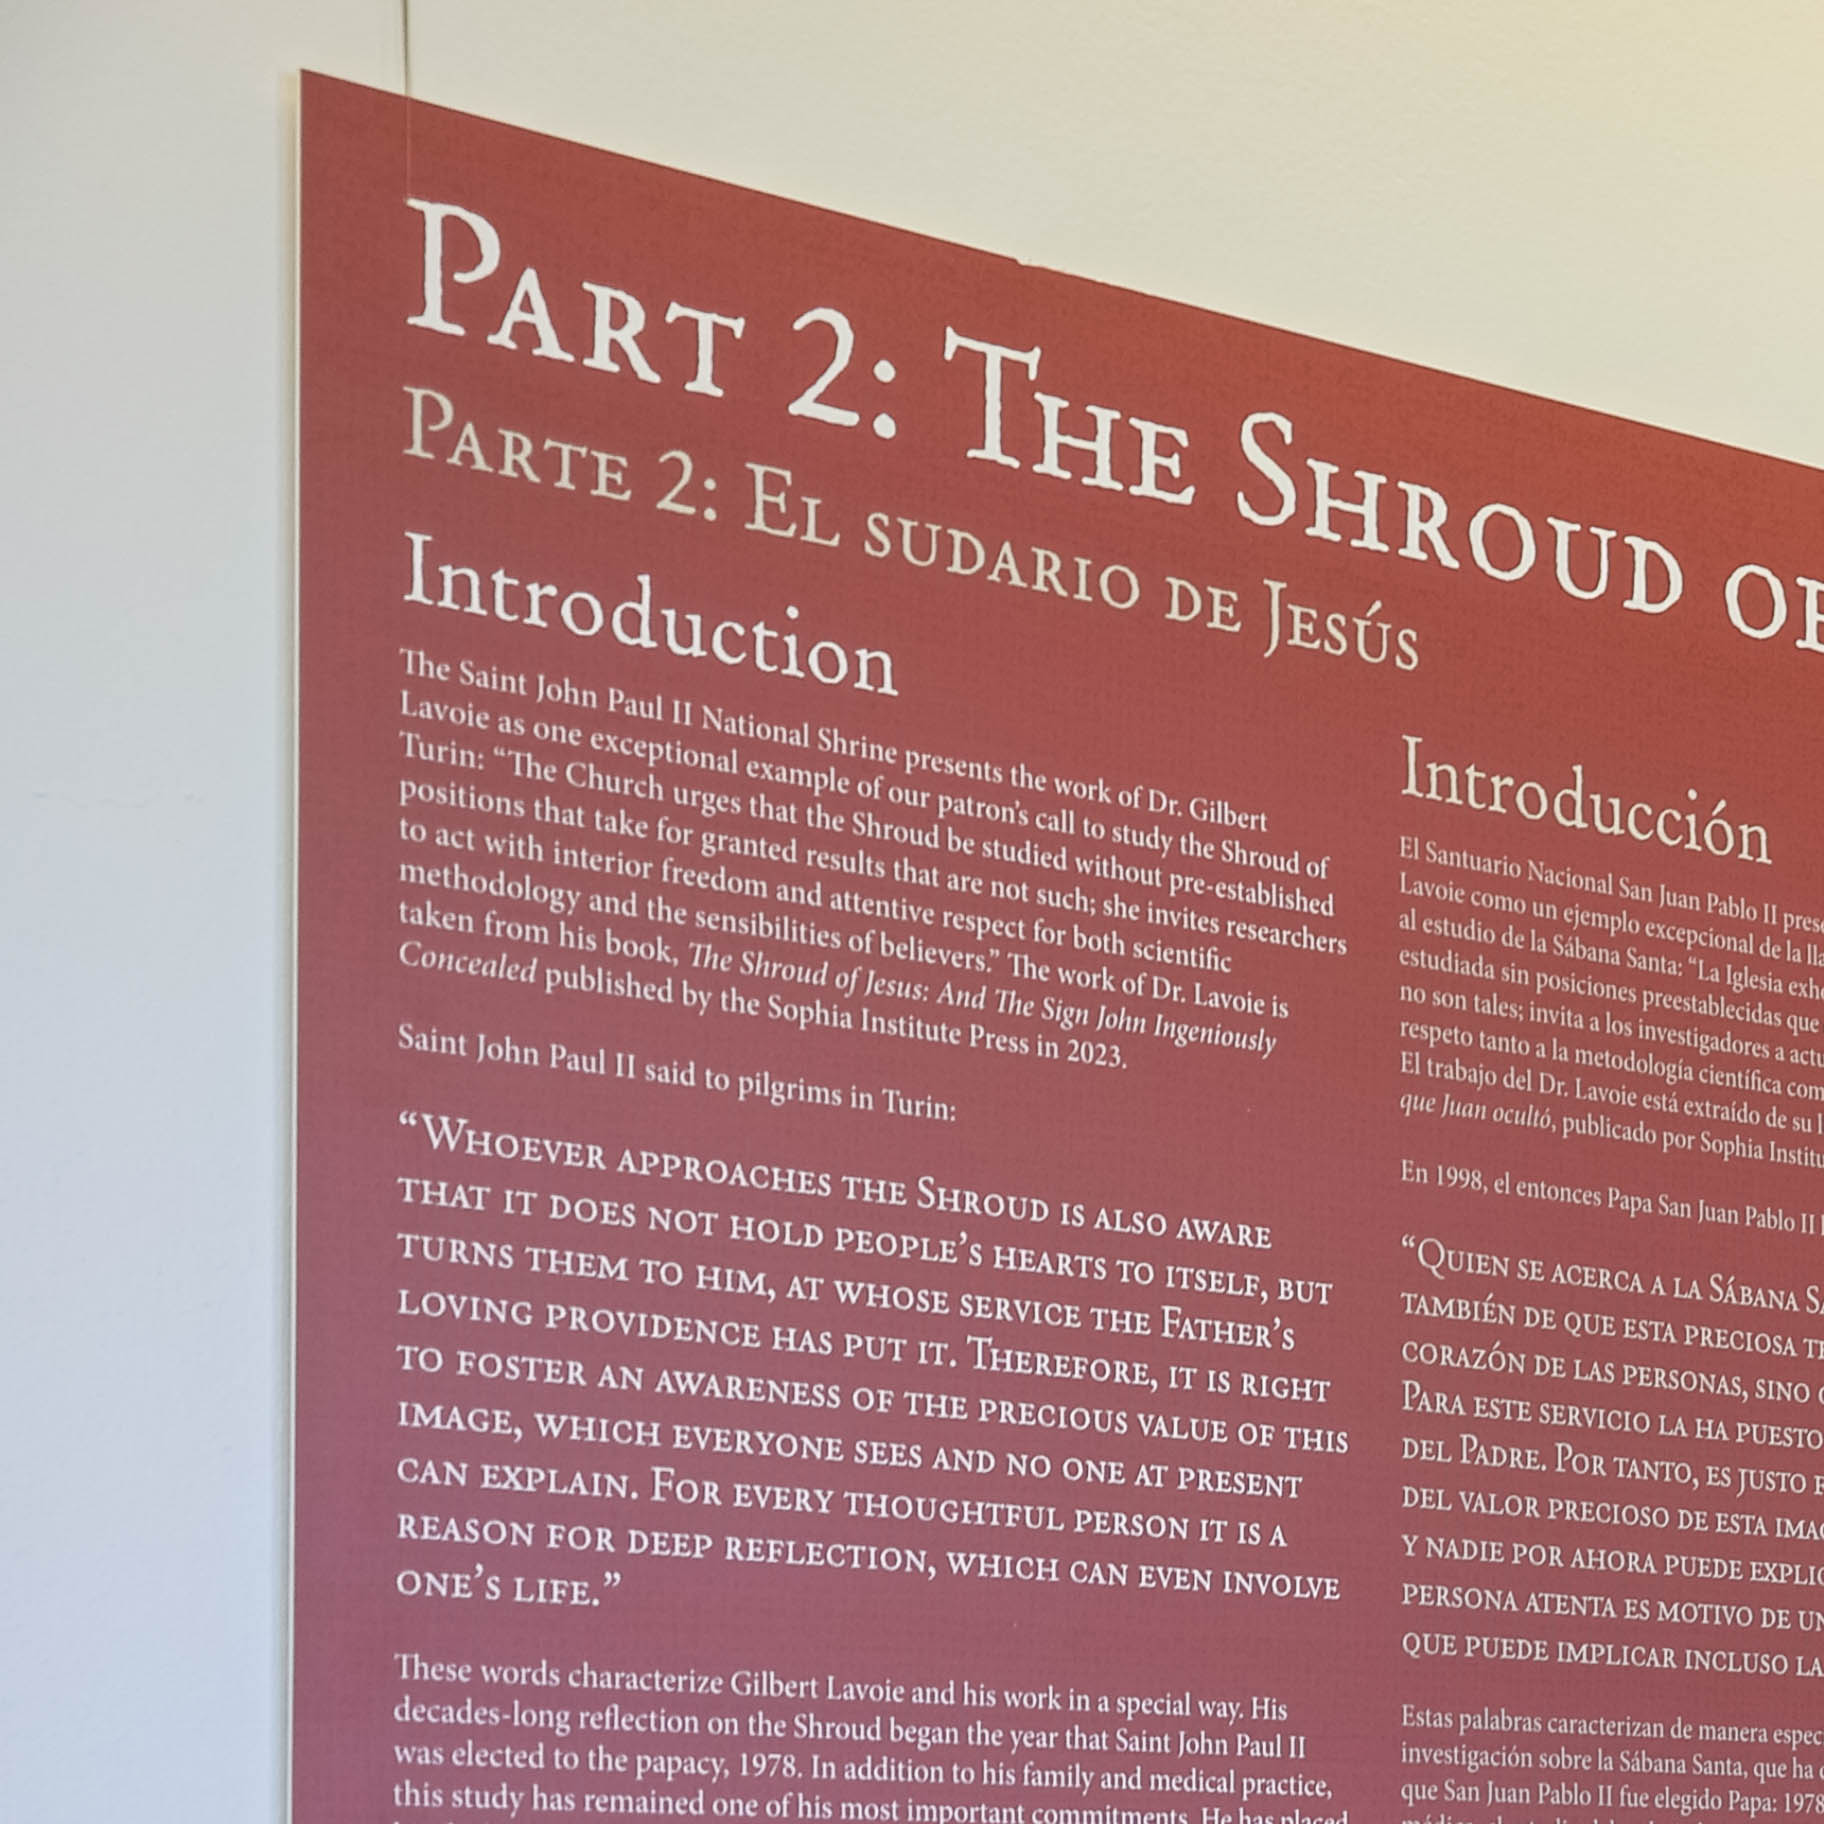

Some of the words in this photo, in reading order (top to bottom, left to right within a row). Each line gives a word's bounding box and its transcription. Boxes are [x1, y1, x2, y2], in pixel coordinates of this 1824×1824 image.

[405, 196, 747, 399] PART
[786, 306, 897, 440] 2:
[942, 325, 1197, 506] THE
[1236, 410, 1684, 615] SHROUD
[402, 384, 633, 502] PARTE
[655, 448, 718, 522] 2:
[743, 461, 841, 548] EL
[863, 511, 1141, 611] SUDARIO
[1164, 575, 1243, 634] DE
[1262, 577, 1420, 672] JESÚS
[402, 530, 900, 697] Introduction
[402, 647, 451, 682] The
[458, 659, 528, 697] Saint
[536, 673, 598, 710] John
[607, 686, 663, 722] Paul
[672, 698, 692, 727] II
[701, 704, 810, 749] National
[817, 726, 898, 765] Shrine
[904, 749, 1004, 784] presents
[1009, 762, 1048, 793] the
[1053, 776, 1113, 805] work
[1117, 784, 1144, 810] of
[1147, 787, 1183, 818] Dr.
[1188, 796, 1268, 834] Gilbert
[1400, 733, 1774, 866] Introducción
[397, 1022, 468, 1058] Saint
[476, 1032, 540, 1067] John
[549, 1042, 607, 1076] Paul
[615, 1051, 636, 1080] II
[645, 1059, 697, 1088] said
[704, 1067, 731, 1092] to
[737, 1070, 843, 1108] pilgrims
[850, 1084, 875, 1112] in
[881, 1087, 957, 1123] Turin:
[398, 1109, 608, 1171] “WHOEVER
[616, 1148, 832, 1198] APPROACHES
[840, 1174, 909, 1207] THE
[916, 1174, 1050, 1223] SHROUD
[1060, 1202, 1086, 1228] IS
[1092, 1206, 1168, 1238] ALSO
[1175, 1216, 1273, 1250] AWARE
[1400, 1233, 1511, 1280] “QUIEN
[1516, 1257, 1546, 1283] SE
[1549, 1262, 1646, 1295] ACERCA
[1649, 1274, 1668, 1297] A
[1672, 1276, 1704, 1301] LA
[1708, 1272, 1801, 1313] SÁBANA
